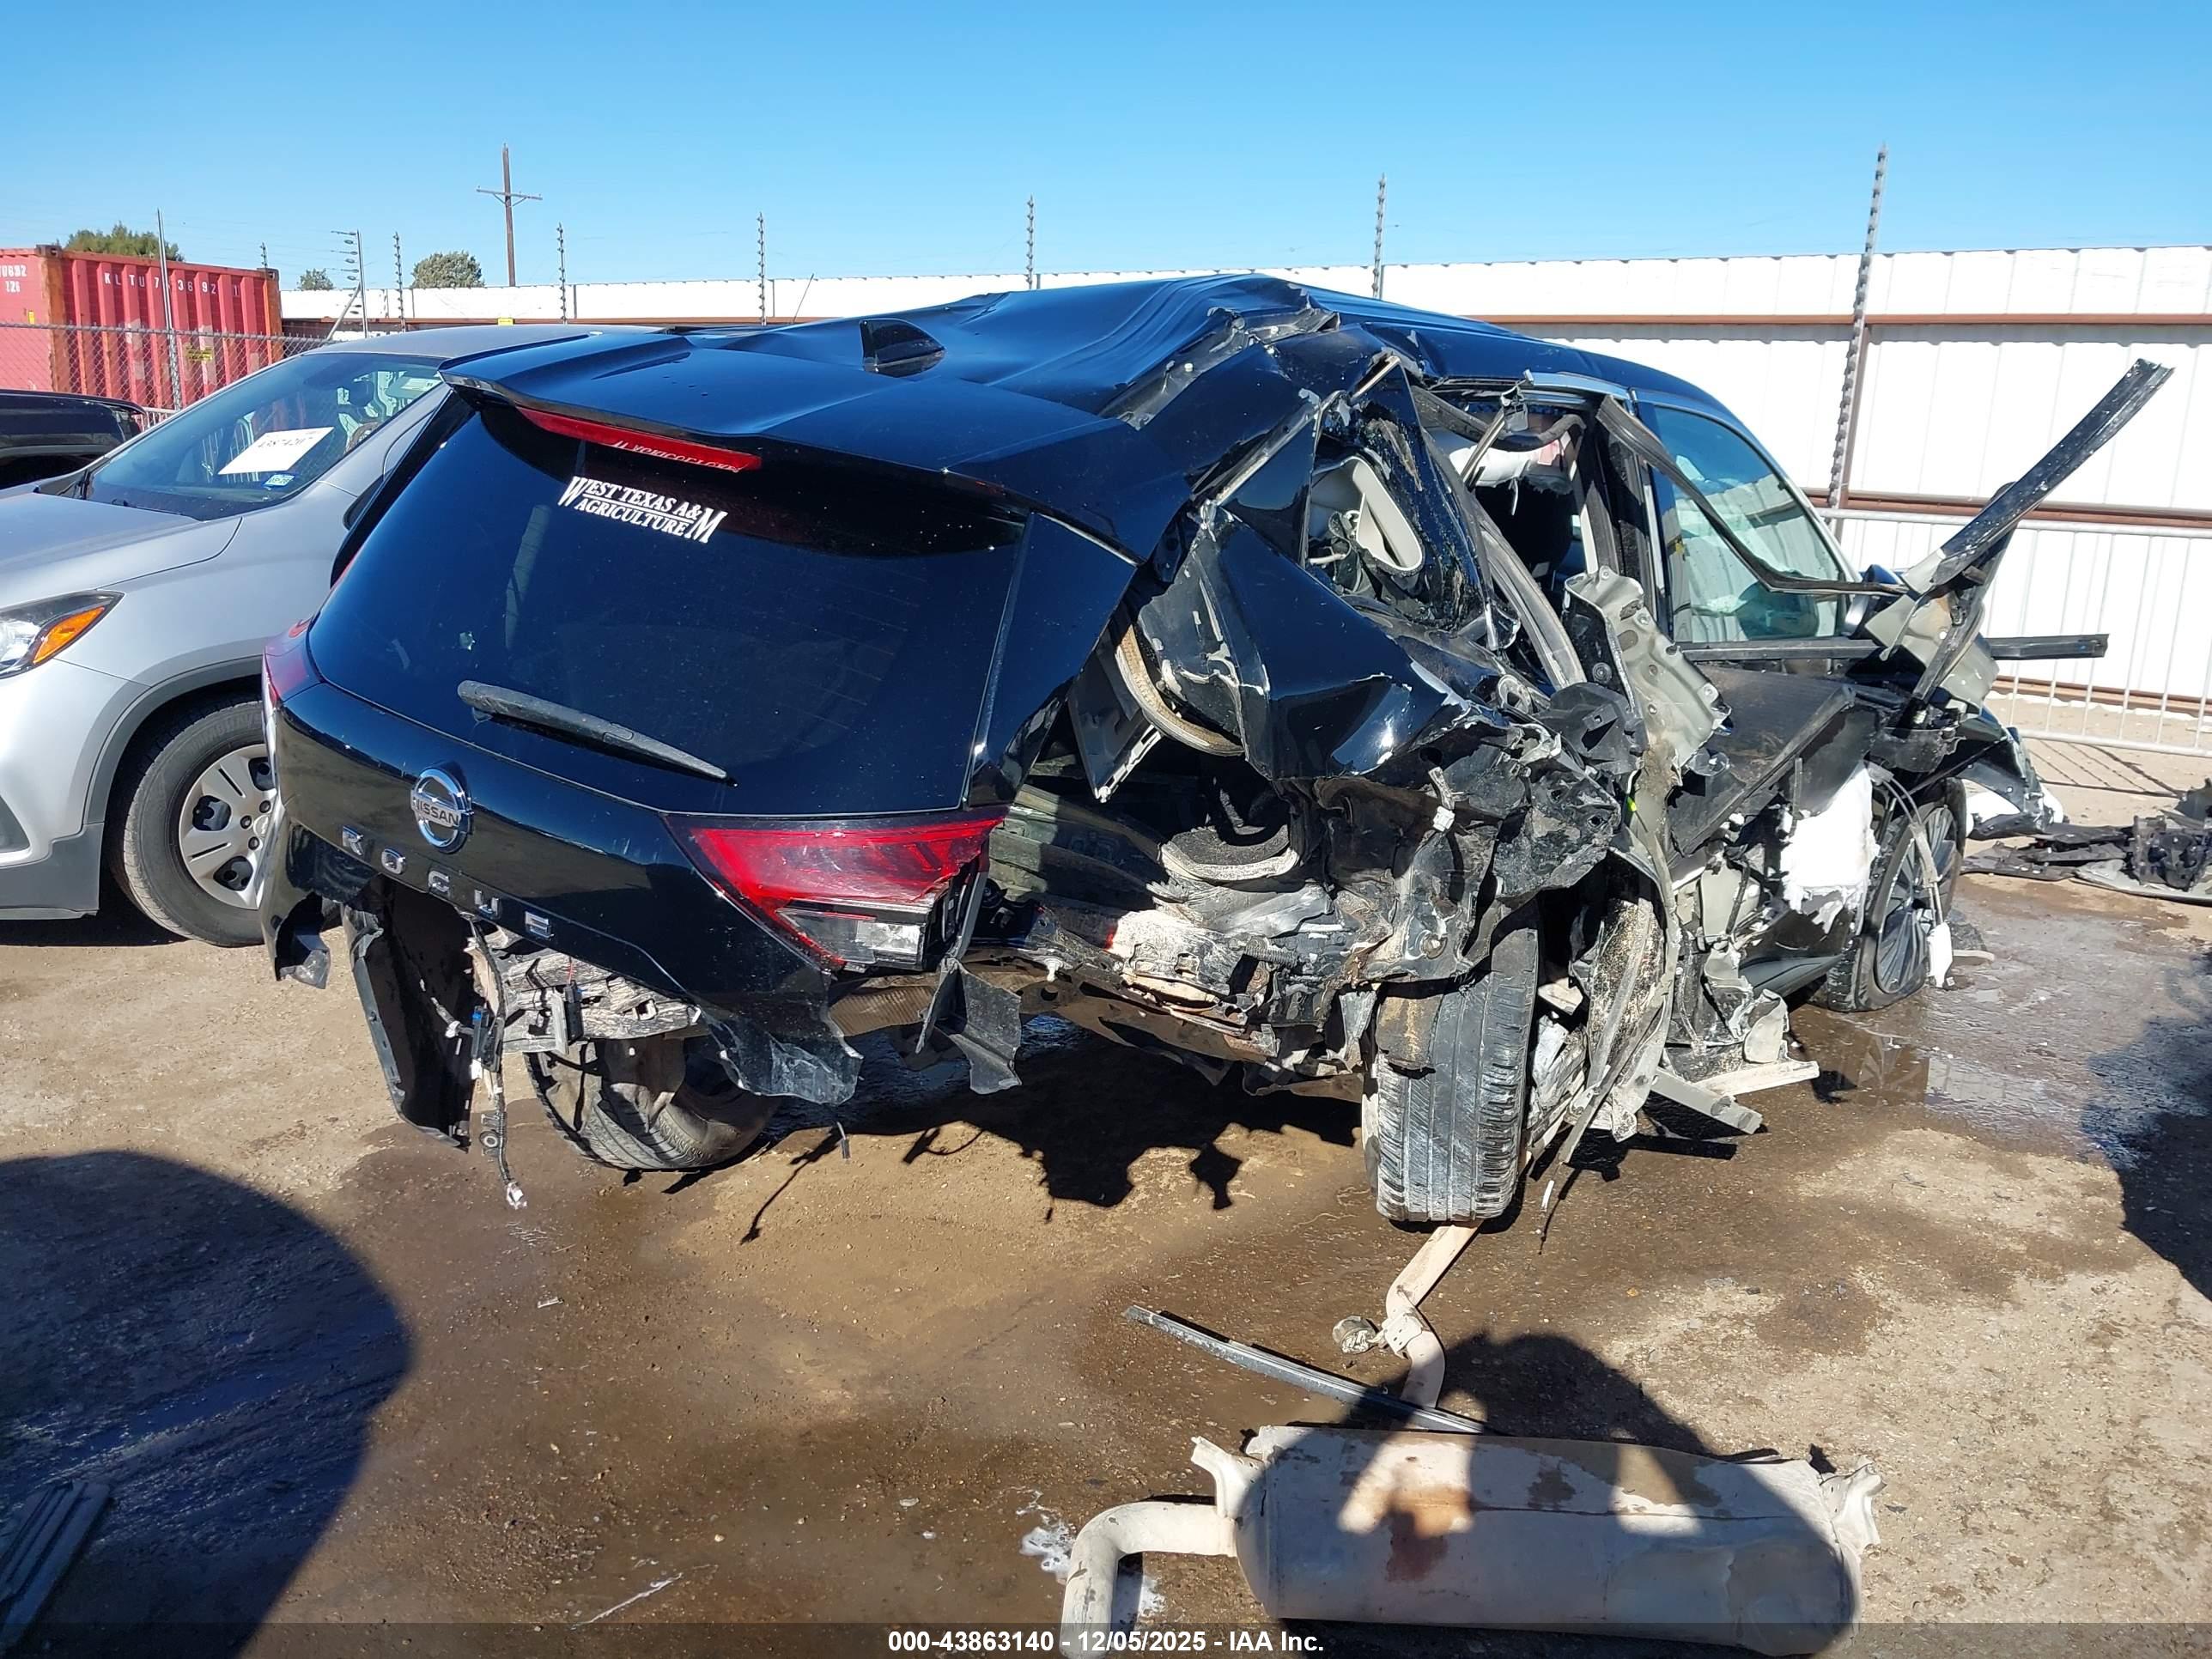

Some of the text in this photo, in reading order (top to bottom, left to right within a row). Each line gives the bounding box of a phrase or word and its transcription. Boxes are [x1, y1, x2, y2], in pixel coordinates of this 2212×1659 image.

[557, 476, 728, 544] WEST TEXAS A&M
[577, 498, 690, 538] AGRICULTURE
[412, 799, 459, 825] NISSAN
[342, 824, 554, 939] ROGUE
